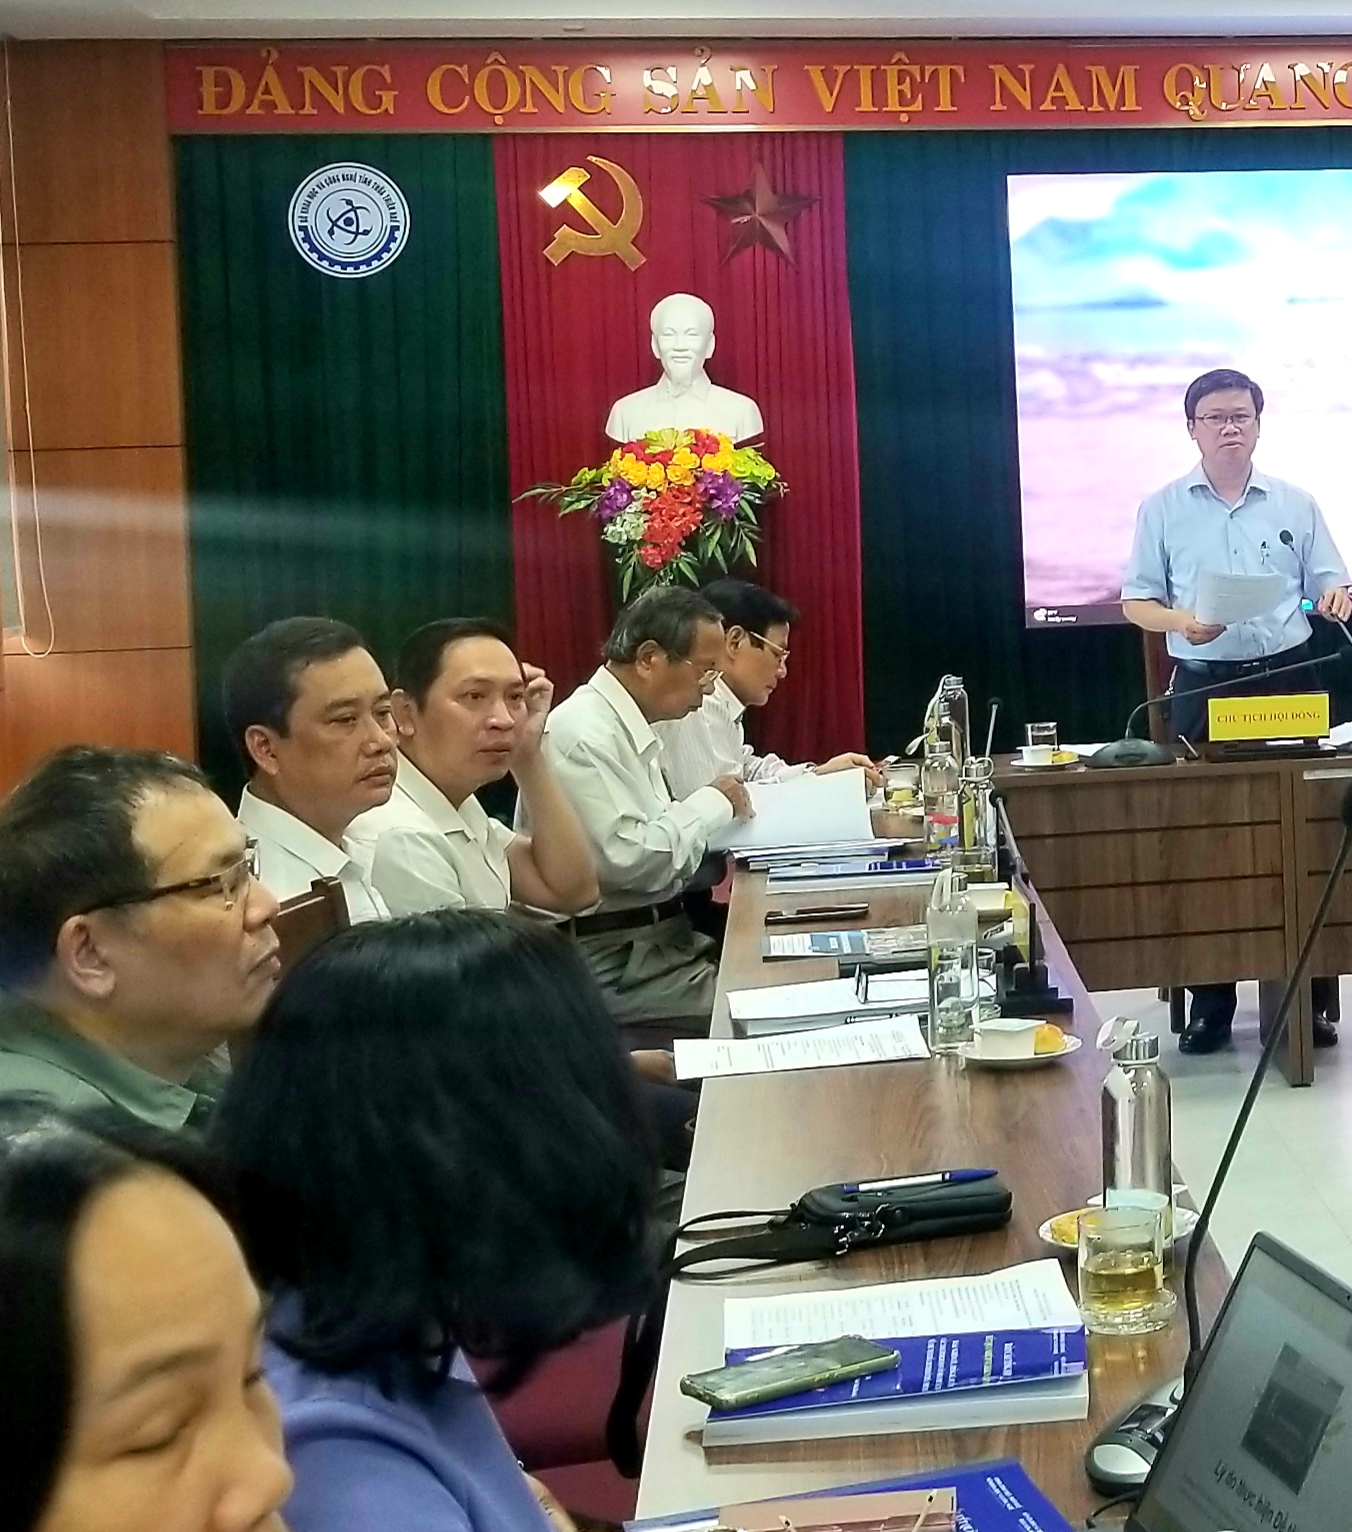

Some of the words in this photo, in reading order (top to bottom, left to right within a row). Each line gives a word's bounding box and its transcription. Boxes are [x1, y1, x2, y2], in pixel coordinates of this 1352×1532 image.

[195, 47, 398, 115] ĐẢNG
[427, 51, 616, 125] CỘNG
[643, 45, 777, 115] SẢN
[803, 51, 964, 123] VIỆT
[989, 63, 1139, 112] NAM
